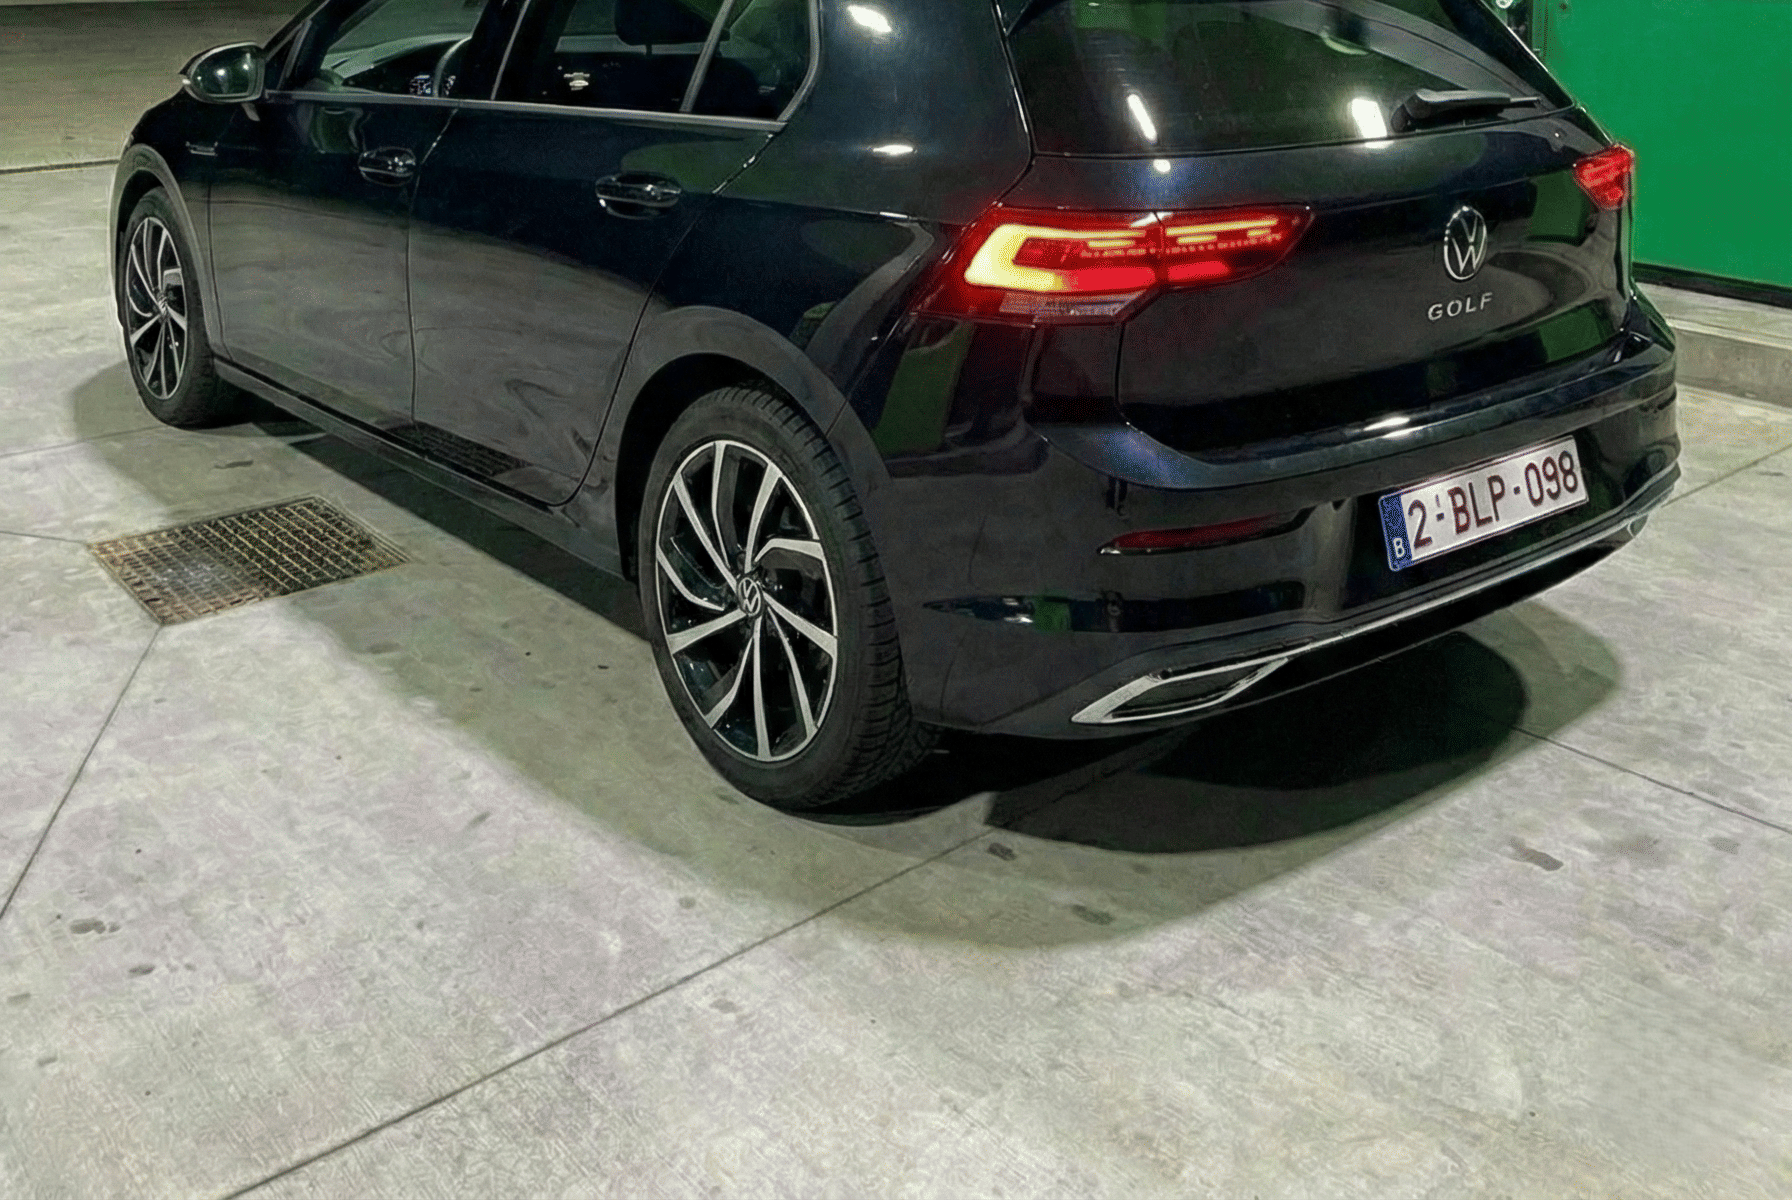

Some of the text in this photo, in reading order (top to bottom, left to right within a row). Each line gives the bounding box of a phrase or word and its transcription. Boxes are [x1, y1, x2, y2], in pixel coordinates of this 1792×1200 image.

[1427, 291, 1493, 321] GOLF
[1407, 450, 1579, 550] 2-BLP-098
[1393, 537, 1406, 559] B
